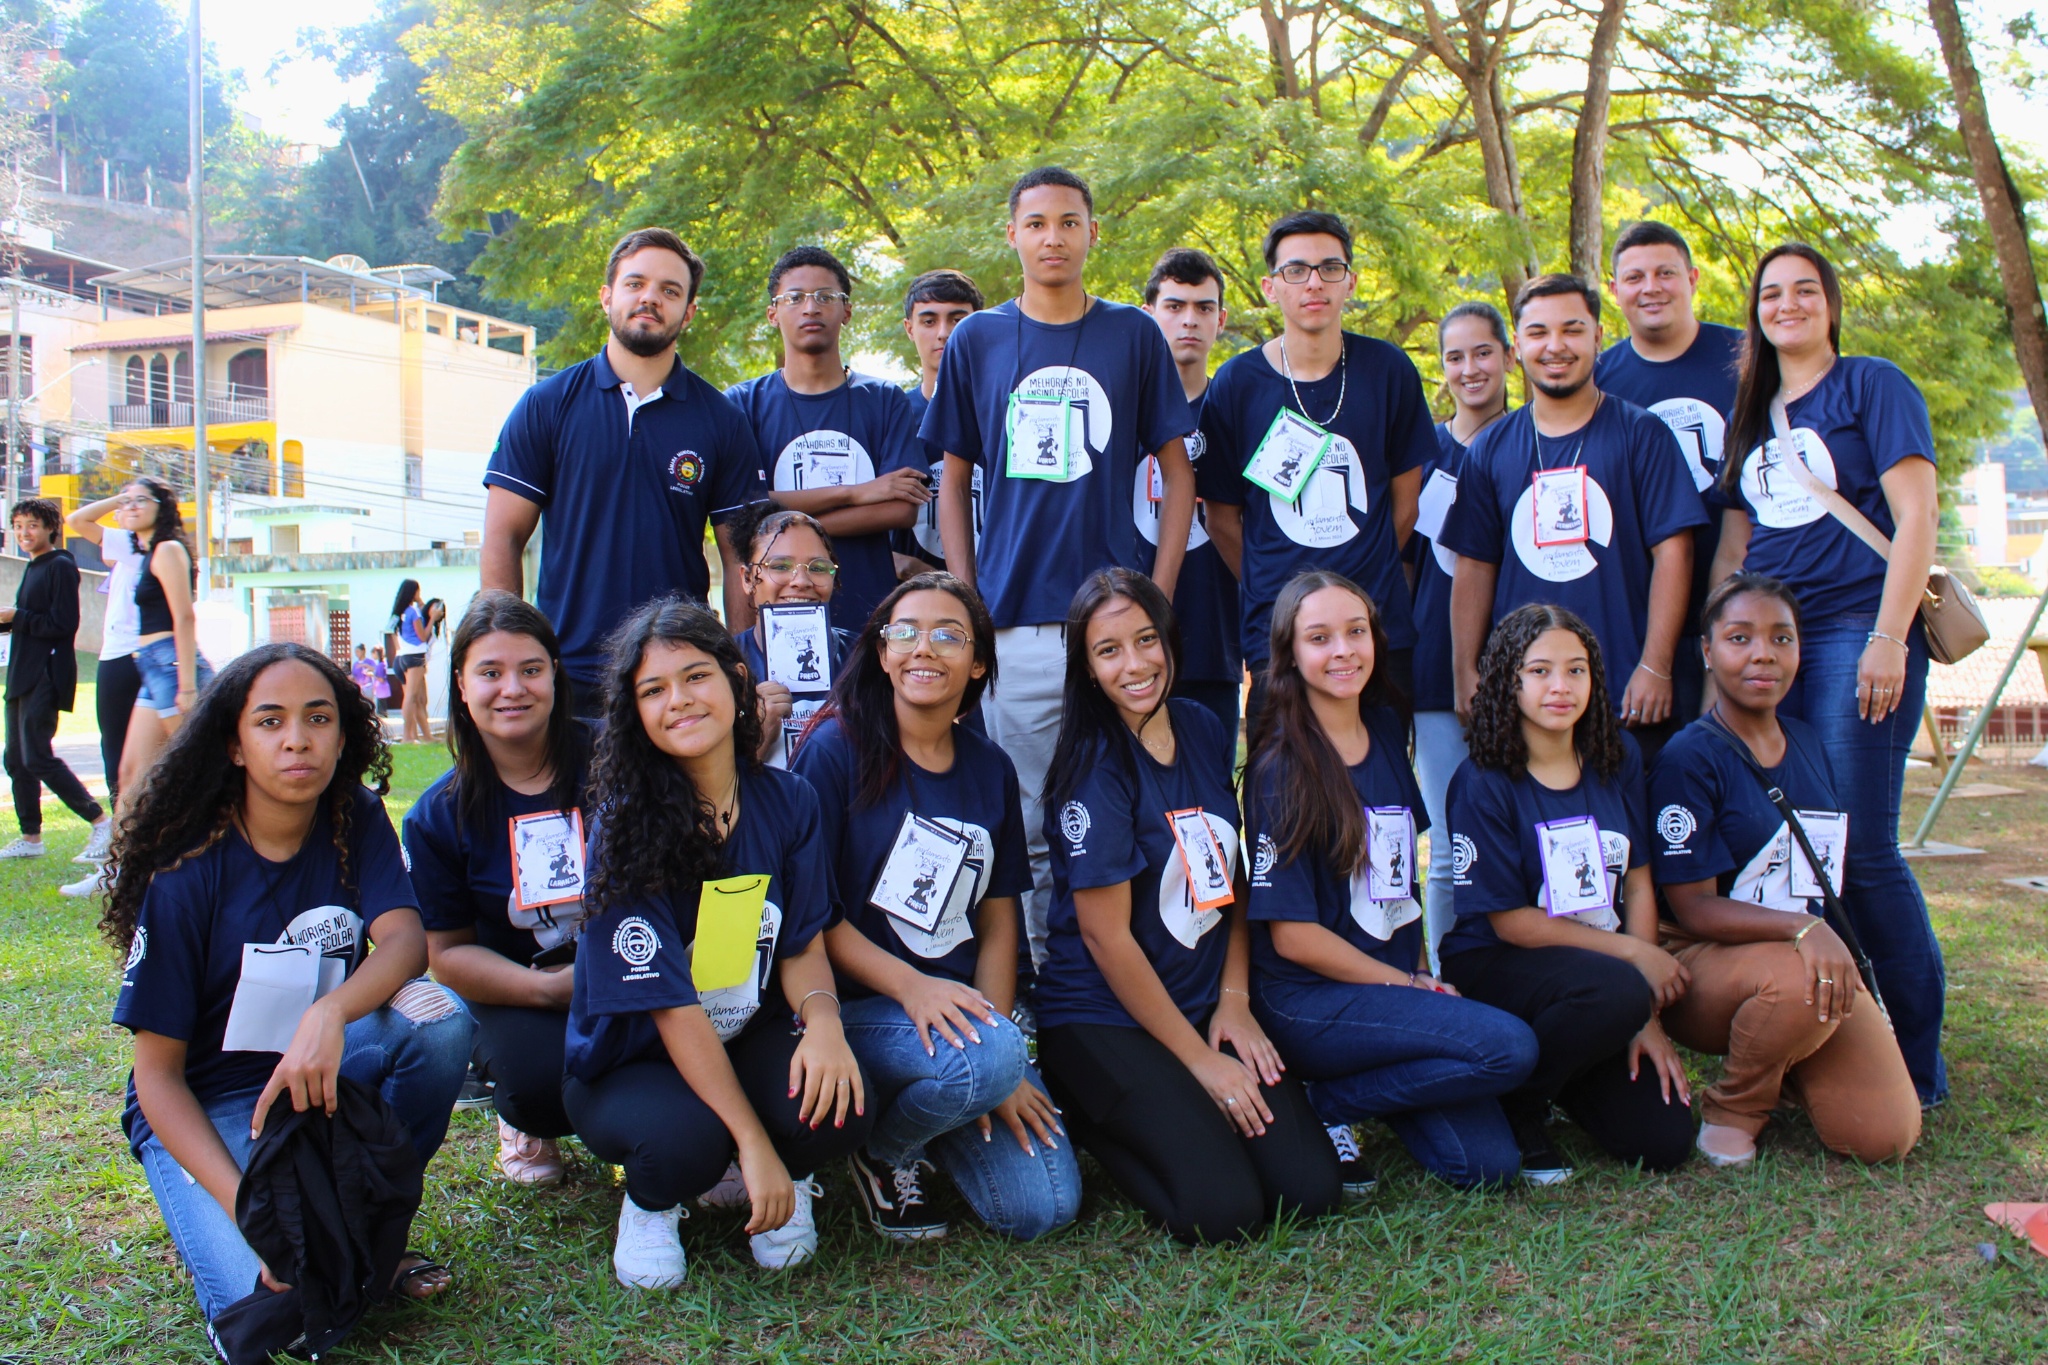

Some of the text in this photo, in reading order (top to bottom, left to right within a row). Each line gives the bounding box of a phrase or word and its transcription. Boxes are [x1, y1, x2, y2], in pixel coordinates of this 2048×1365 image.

[1030, 376, 1087, 388] MELHORIAS NO
[1656, 403, 1698, 419] HORIAS NO
[796, 438, 848, 450] MEHORIAS NO
[1334, 441, 1346, 452] NO
[800, 672, 819, 680] PRETO
[969, 829, 982, 842] NO
[1608, 837, 1621, 851] NO
[906, 897, 927, 913] PRETO
[333, 913, 348, 931] NO
[622, 972, 660, 981] LEGISLATIVO
[704, 1000, 757, 1019] arlamento
[712, 1018, 748, 1030] ovem
